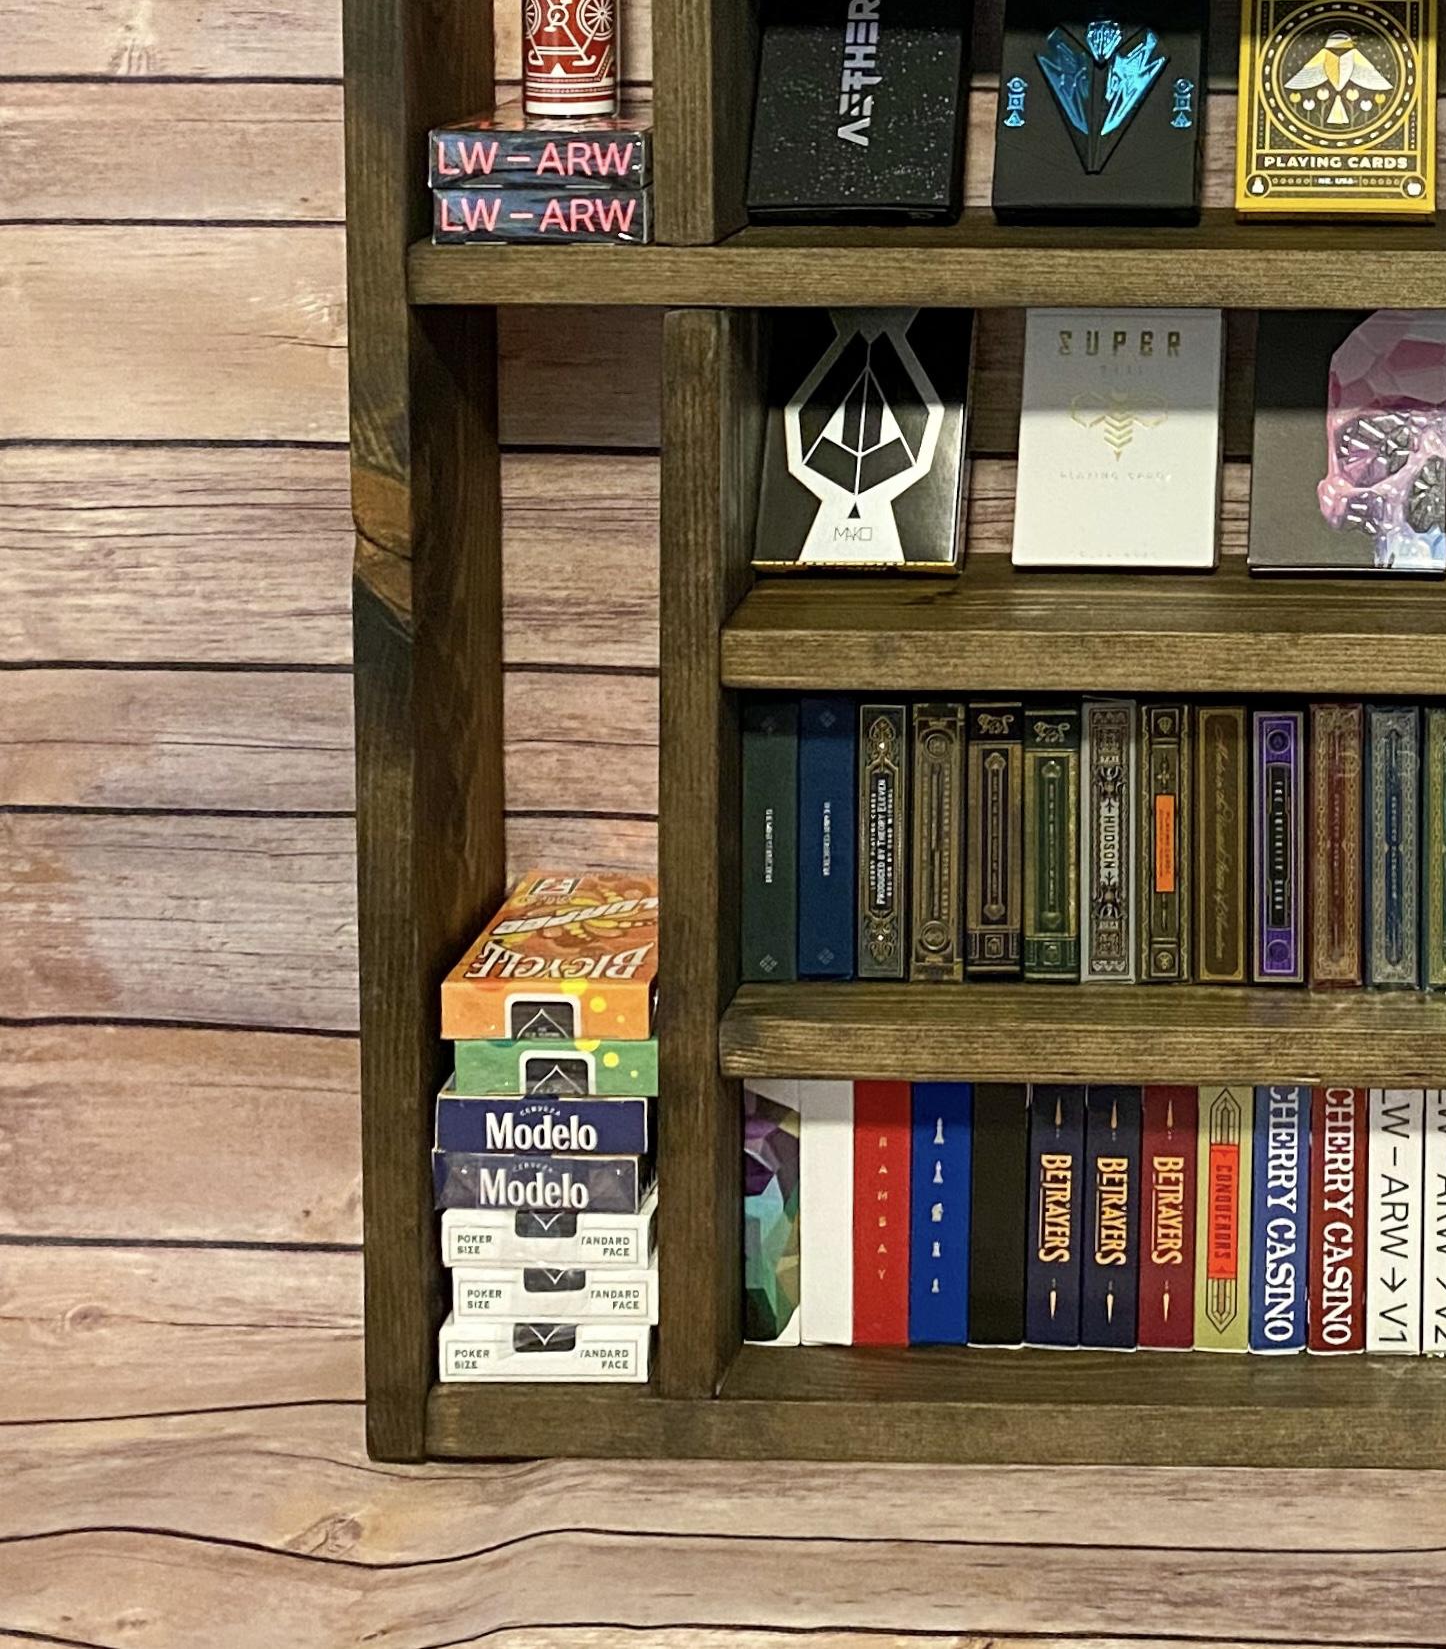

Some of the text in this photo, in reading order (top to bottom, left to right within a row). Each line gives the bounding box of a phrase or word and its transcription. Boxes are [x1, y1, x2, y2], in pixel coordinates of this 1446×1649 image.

[438, 141, 633, 175] LW ARW
[1264, 156, 1408, 170] PLAYING CARDS
[441, 198, 636, 232] LW ARW
[1059, 331, 1181, 356] SUPER
[833, 527, 873, 542] MAKO
[1103, 815, 1116, 869] HUDSON
[465, 941, 655, 980] BICYCLE
[519, 1106, 561, 1117] CERVEZA
[485, 1112, 598, 1151] Modelo
[479, 1168, 589, 1209] Modelo
[1038, 1154, 1073, 1261] BETRAYERS
[1094, 1157, 1128, 1265] BETRAYERS
[1151, 1156, 1184, 1264] BETRAYERS
[1214, 1165, 1232, 1259] CONQUERORS
[1264, 1086, 1298, 1341] CHERRY CASINO
[1322, 1088, 1354, 1345] CHERRY CASINO
[457, 1235, 492, 1243] POKER
[458, 1246, 480, 1254] SIZE
[603, 1248, 630, 1257] FACE
[1379, 1174, 1409, 1342] ARW V1
[467, 1290, 502, 1298] POKER
[468, 1300, 489, 1309] SIZE
[613, 1301, 639, 1309] FACE
[454, 1349, 489, 1358] POKER
[454, 1360, 478, 1369] SIZE
[602, 1360, 629, 1369] FACE
